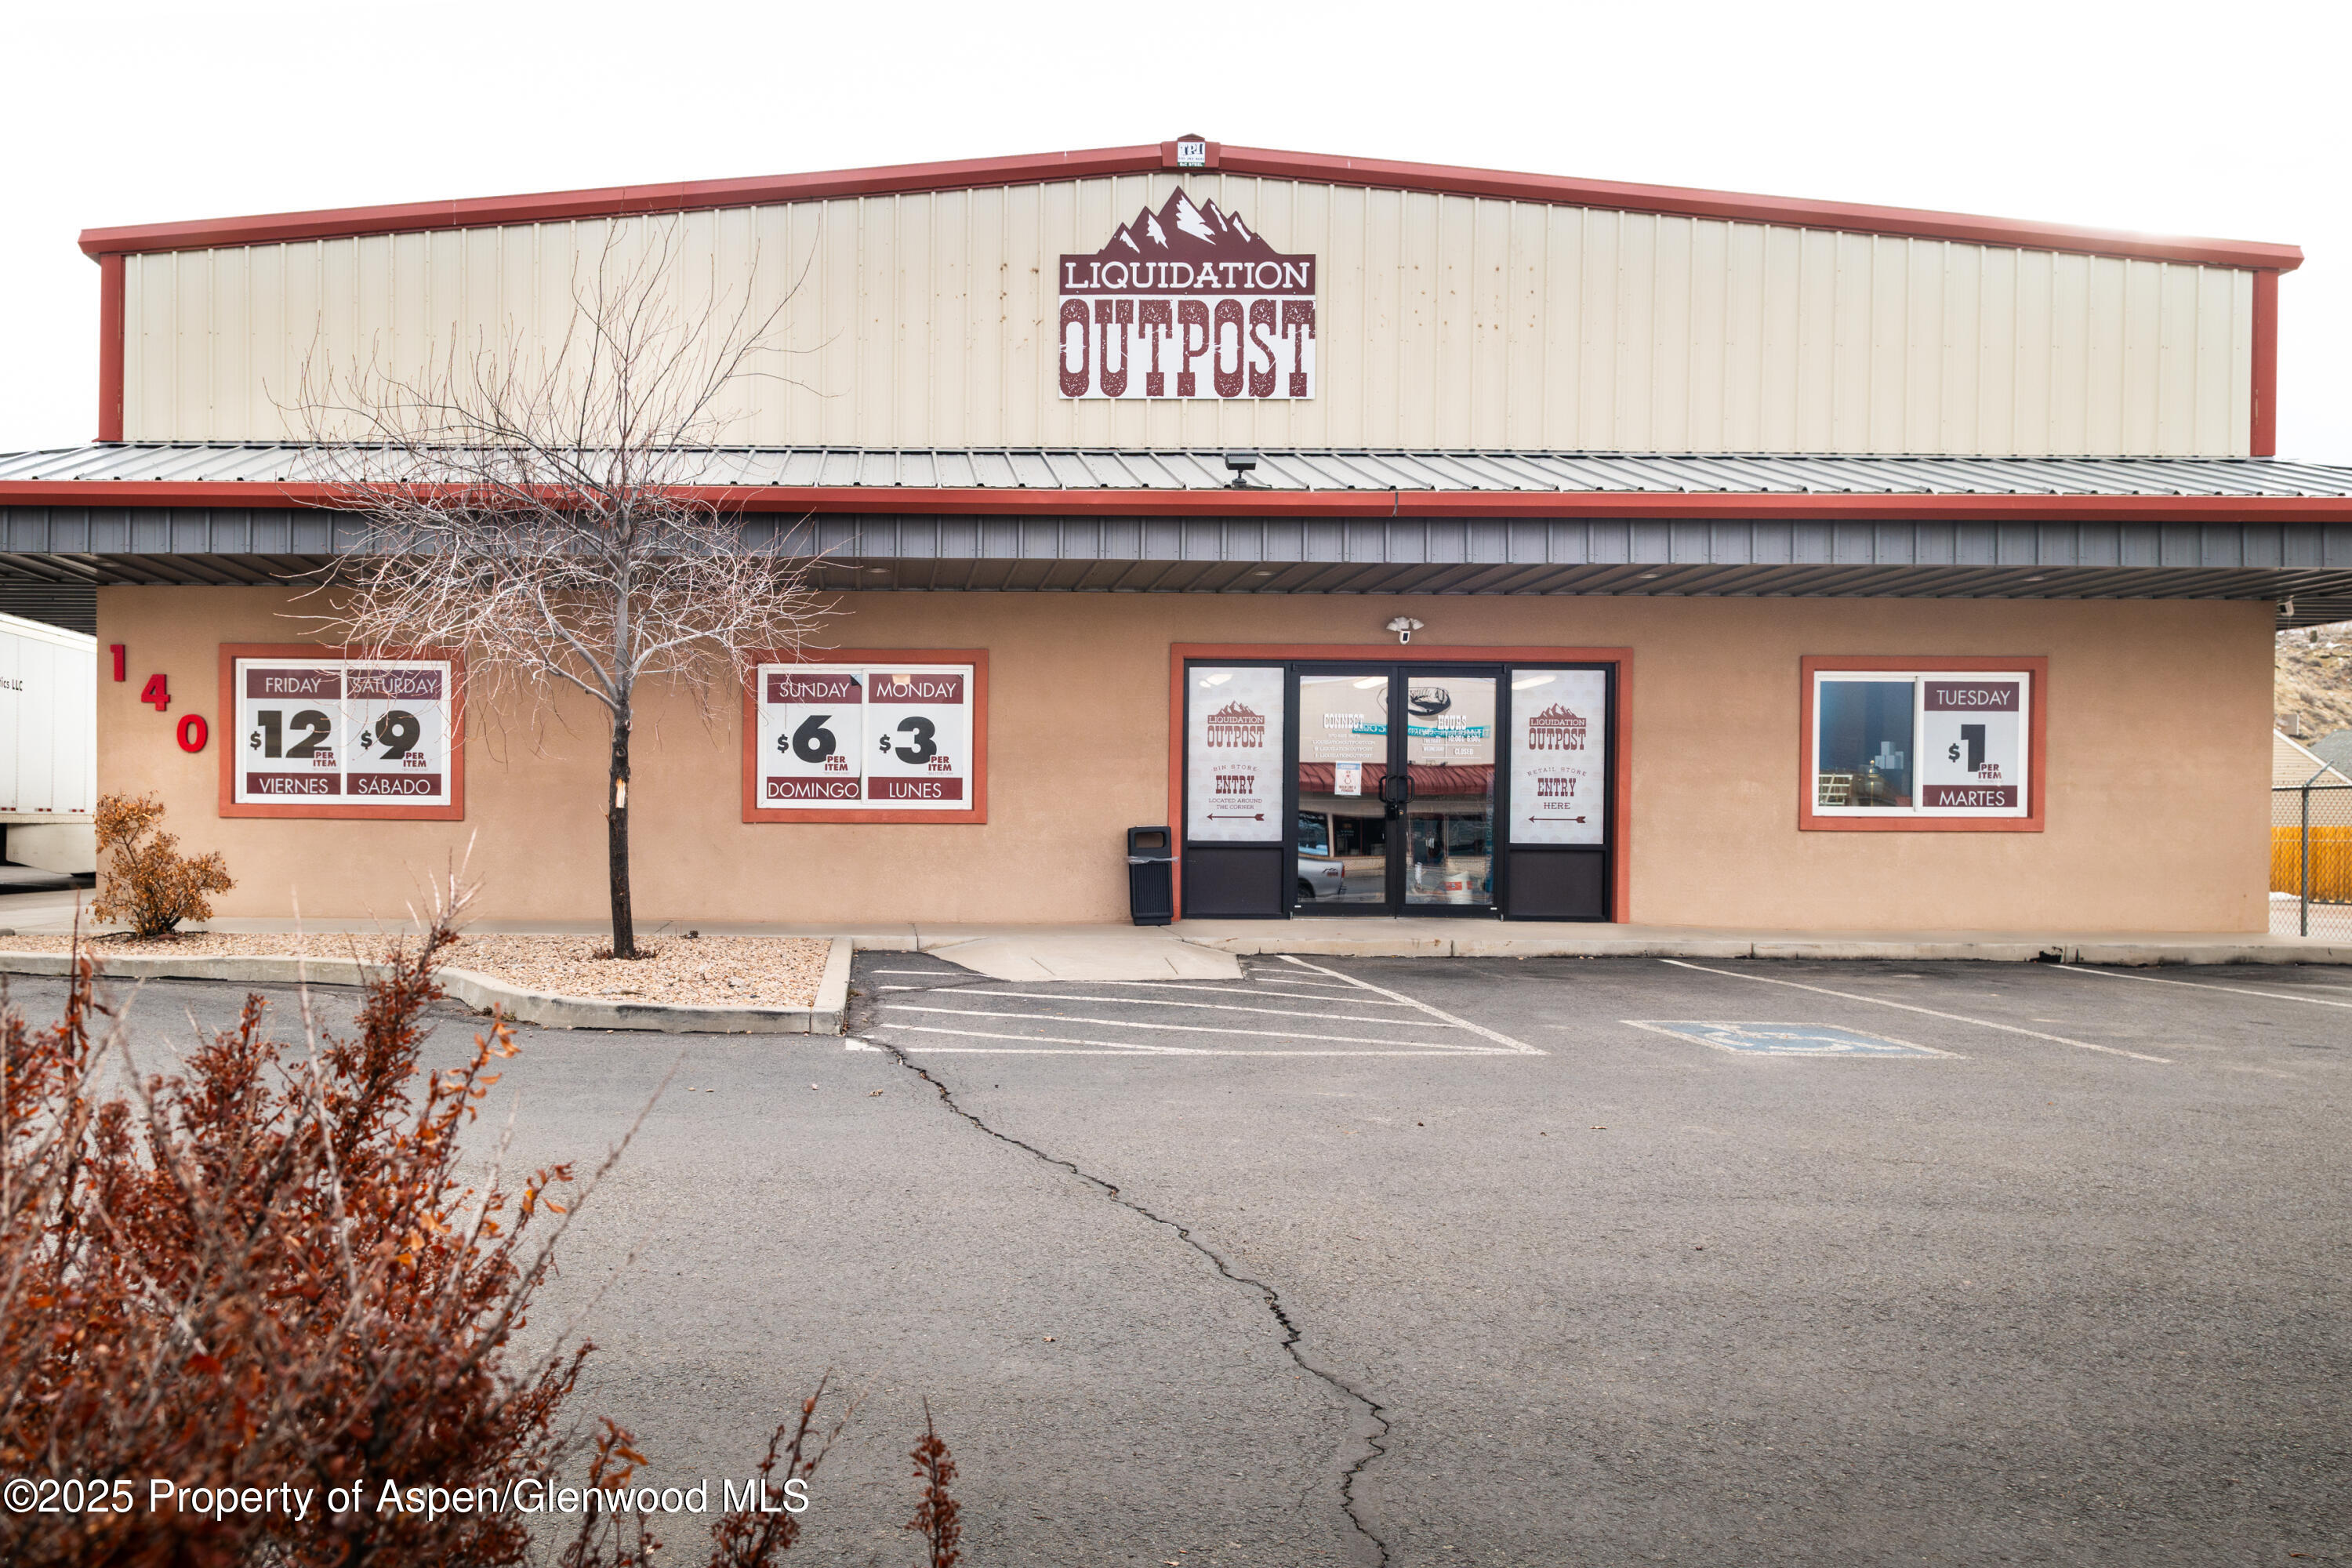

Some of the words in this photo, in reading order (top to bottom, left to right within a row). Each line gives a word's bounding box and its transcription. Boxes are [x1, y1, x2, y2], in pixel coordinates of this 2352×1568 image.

[1065, 261, 1310, 289] LIQUIDATION
[1059, 299, 1316, 397] OUTPOST
[12, 678, 23, 691] LLC
[265, 677, 321, 693] FRIDAY
[352, 678, 437, 694] SATURDAY
[779, 682, 849, 698] SUNDAY
[877, 682, 956, 698] MONDAY
[1936, 690, 2011, 706] TUESDAY
[1323, 713, 1364, 729] CONNECT
[1437, 715, 1466, 730] HOURS
[250, 710, 332, 758] $12
[361, 710, 420, 760] $9
[777, 714, 837, 764] $6
[879, 716, 938, 764] $3
[1207, 725, 1265, 747] OUTPOST
[1529, 728, 1586, 750] OUTPOST
[1948, 724, 1986, 772] $1
[824, 763, 848, 771] ITEM
[1527, 767, 1556, 777] RETAIL
[1560, 767, 1587, 777] STORE
[259, 778, 328, 794] VIERNES
[358, 775, 431, 794] SÁBADO
[768, 782, 859, 798] DOMINGO
[889, 782, 942, 798] LUNES
[1216, 775, 1255, 794] ENTRY
[1537, 778, 1576, 797] ENTRY
[1939, 790, 2005, 806] MARTES
